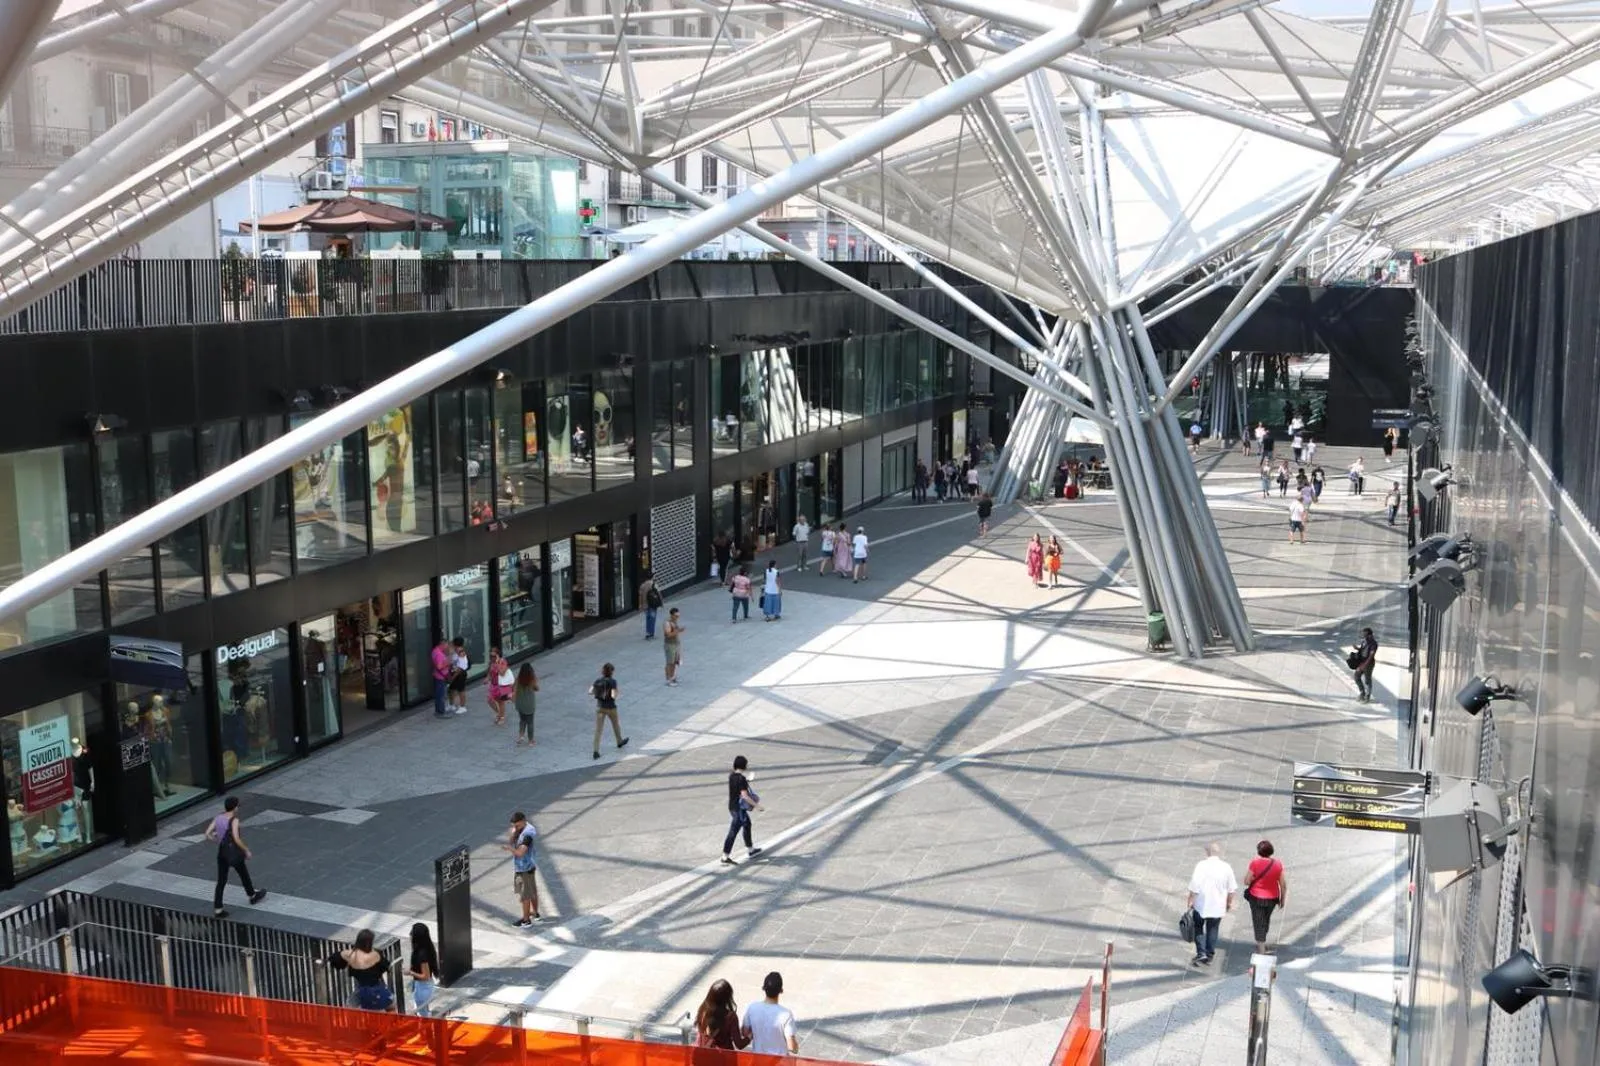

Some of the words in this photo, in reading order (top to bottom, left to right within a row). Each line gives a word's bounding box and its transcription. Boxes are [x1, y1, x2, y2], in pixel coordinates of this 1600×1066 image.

[30, 746, 62, 768] SVUOTA
[32, 763, 64, 784] CASSETTI
[1345, 785, 1378, 795] Centrale
[1355, 803, 1361, 811] 2
[1336, 815, 1407, 830] Circumvesuviana
